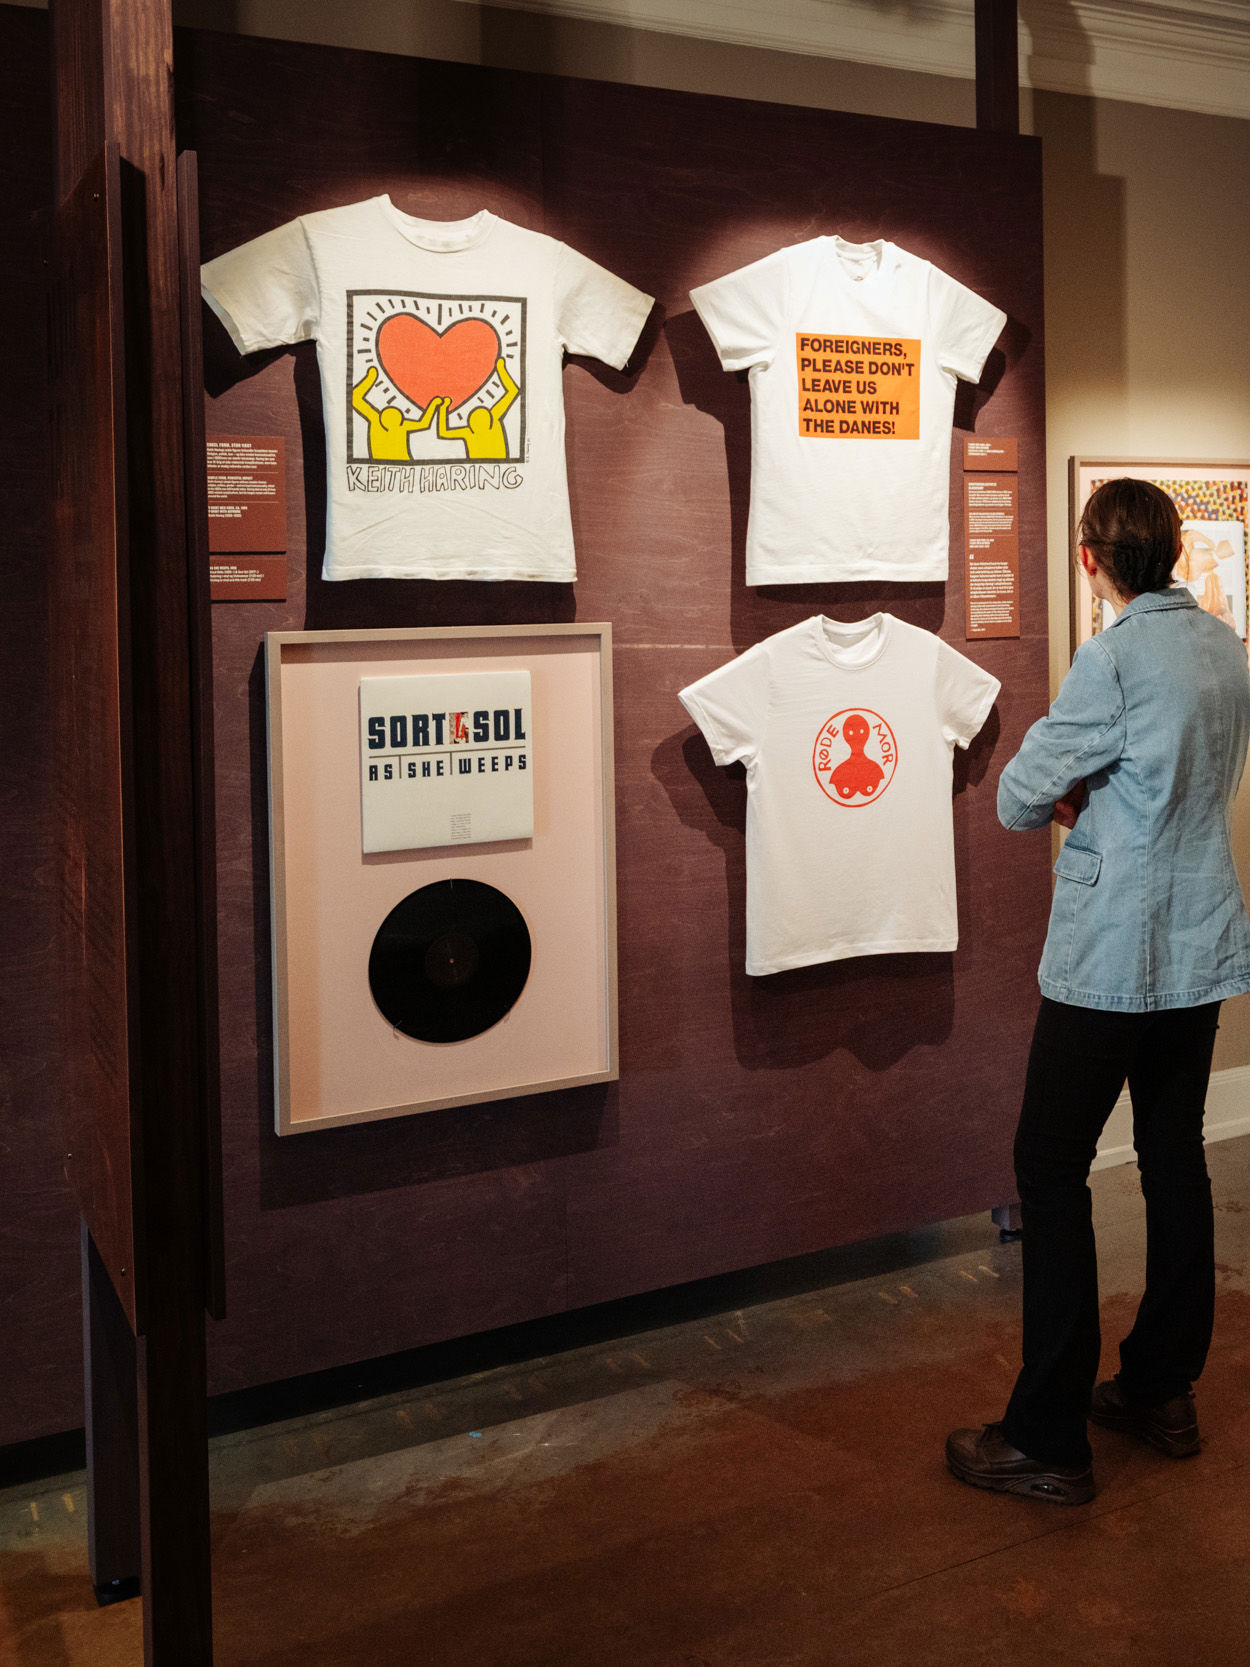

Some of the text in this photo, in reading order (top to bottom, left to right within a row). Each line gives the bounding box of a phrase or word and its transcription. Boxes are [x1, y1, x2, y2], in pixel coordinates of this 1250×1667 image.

[800, 338, 907, 359] FOREIGNERS,
[801, 358, 915, 376] PLEASE DON'T
[802, 378, 877, 394] LEAVE US
[803, 398, 900, 415] ALONE WITH
[803, 418, 896, 434] THE DANES!
[346, 465, 524, 493] KEITH HARING
[368, 708, 526, 749] SORT SOL
[818, 724, 840, 772] RØDE
[872, 723, 894, 766] MOR
[369, 754, 527, 781] AS SHE WEEPS
